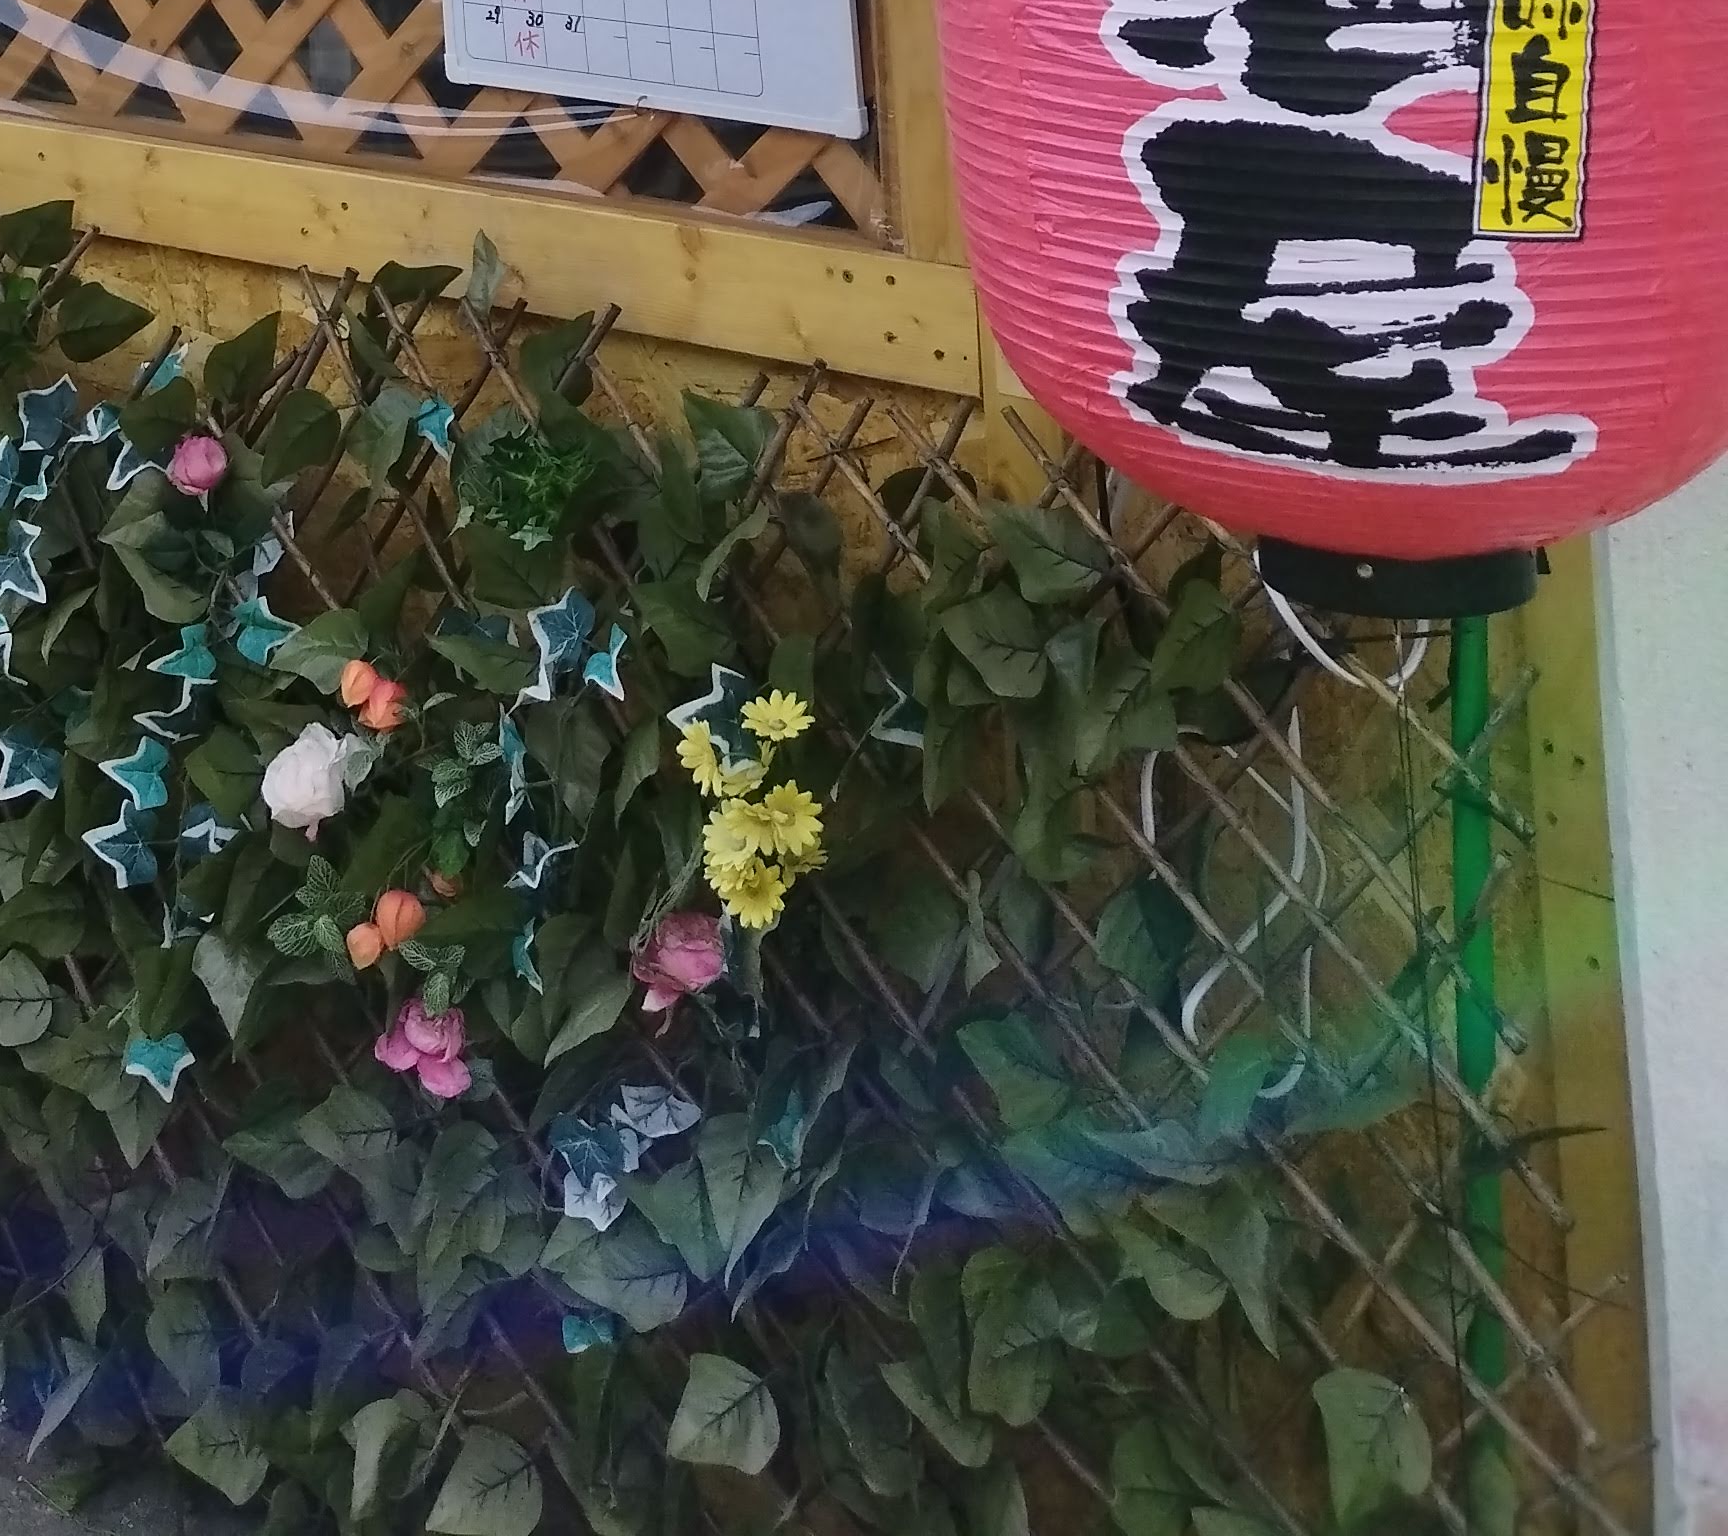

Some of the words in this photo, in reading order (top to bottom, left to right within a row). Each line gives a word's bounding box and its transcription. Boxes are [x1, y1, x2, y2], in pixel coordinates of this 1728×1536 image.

[485, 5, 501, 25] 29
[525, 10, 544, 28] 30
[565, 15, 582, 33] 31
[514, 30, 540, 60] 休
